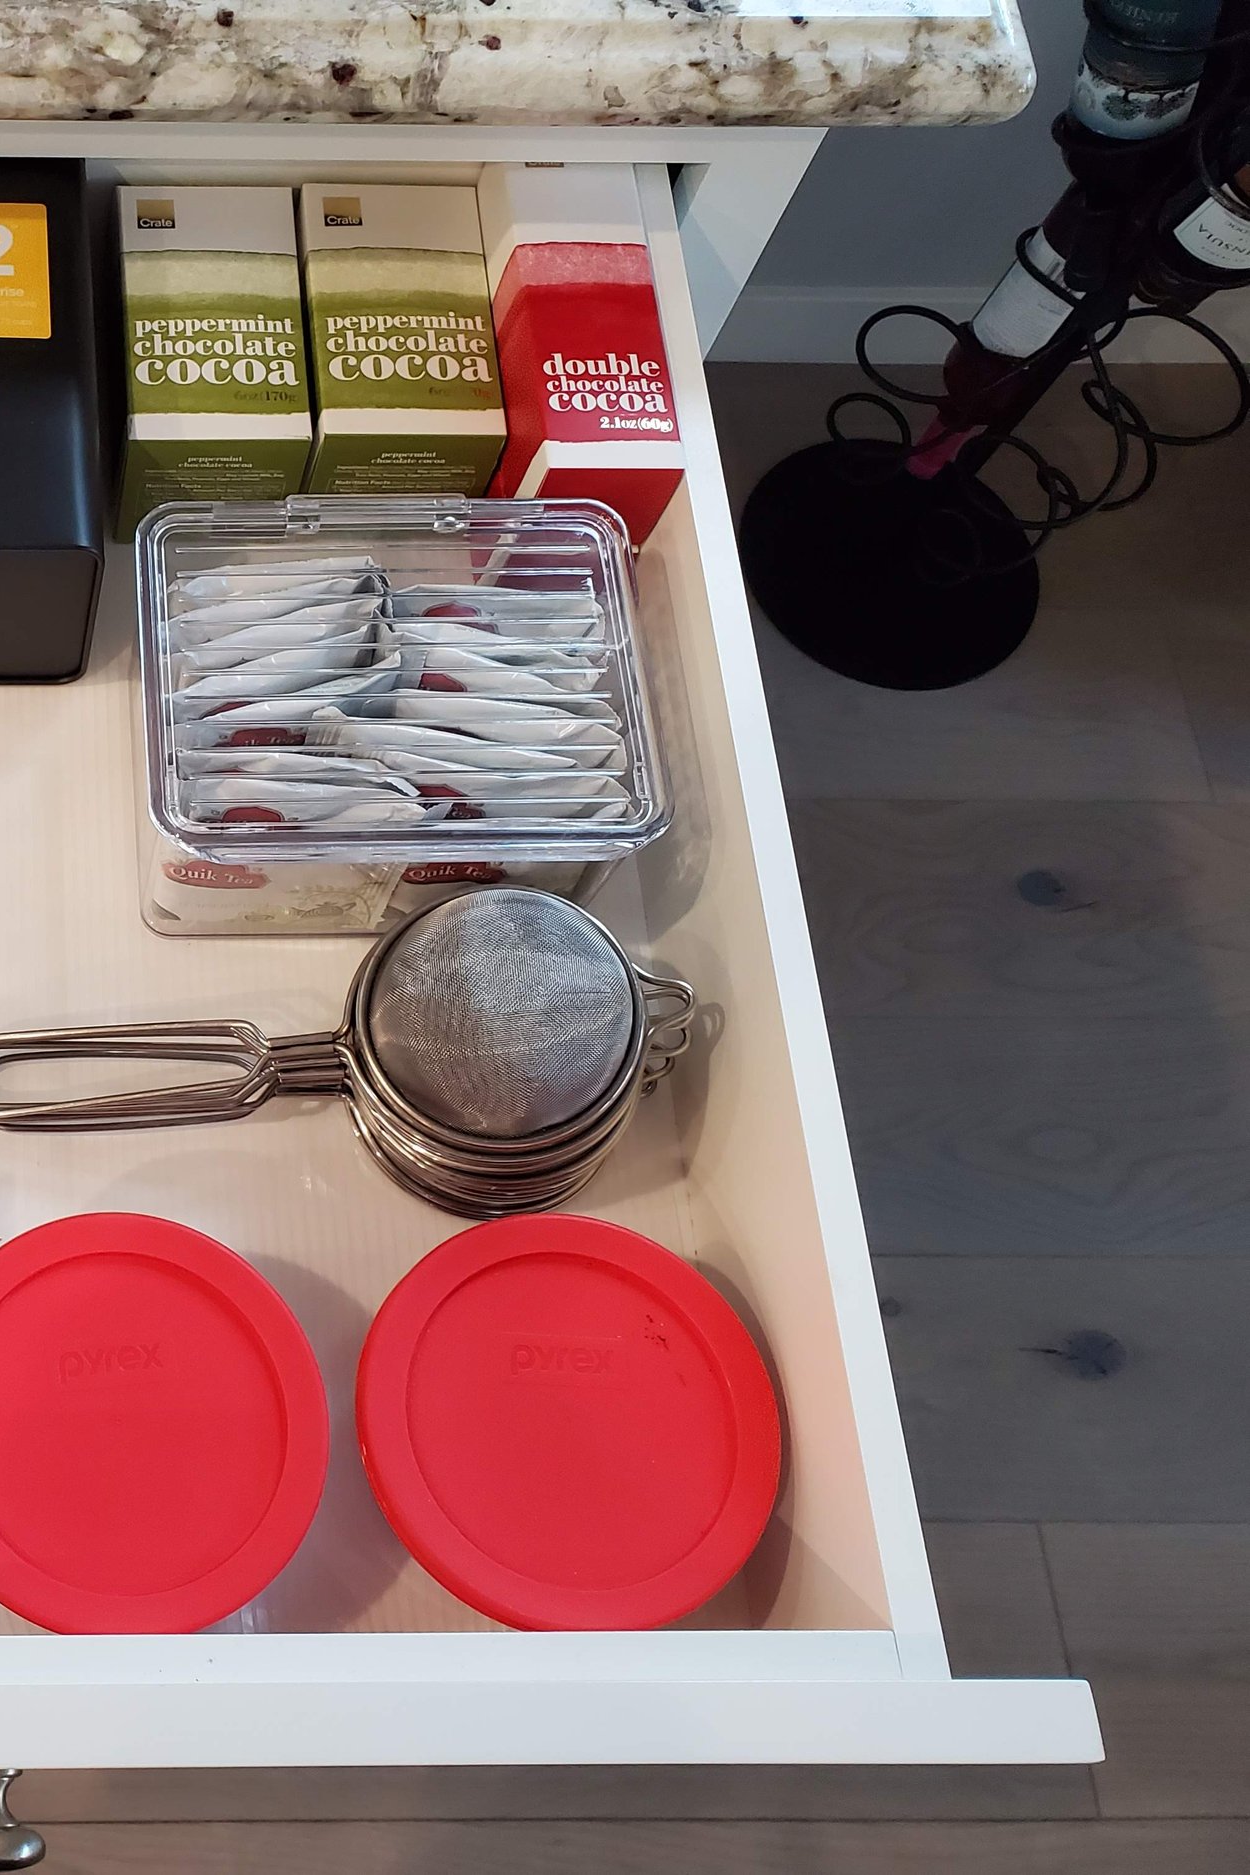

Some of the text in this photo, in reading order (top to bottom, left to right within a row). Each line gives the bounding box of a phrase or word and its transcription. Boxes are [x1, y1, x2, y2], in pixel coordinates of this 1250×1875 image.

[139, 219, 173, 228] Crate
[327, 216, 359, 225] Crate
[134, 314, 295, 337] peppermint
[325, 312, 486, 334] peppermint
[134, 333, 296, 357] chocolate
[326, 330, 488, 354] chocolate
[135, 358, 299, 385] cocoa
[328, 354, 493, 382] cocoa
[543, 353, 660, 377] double
[546, 376, 664, 393] chocolate
[548, 392, 668, 413] cocoa
[170, 865, 217, 882] Quik
[409, 865, 457, 881] Quik
[57, 1343, 164, 1385] pyrex
[510, 1344, 614, 1378] pyrex
